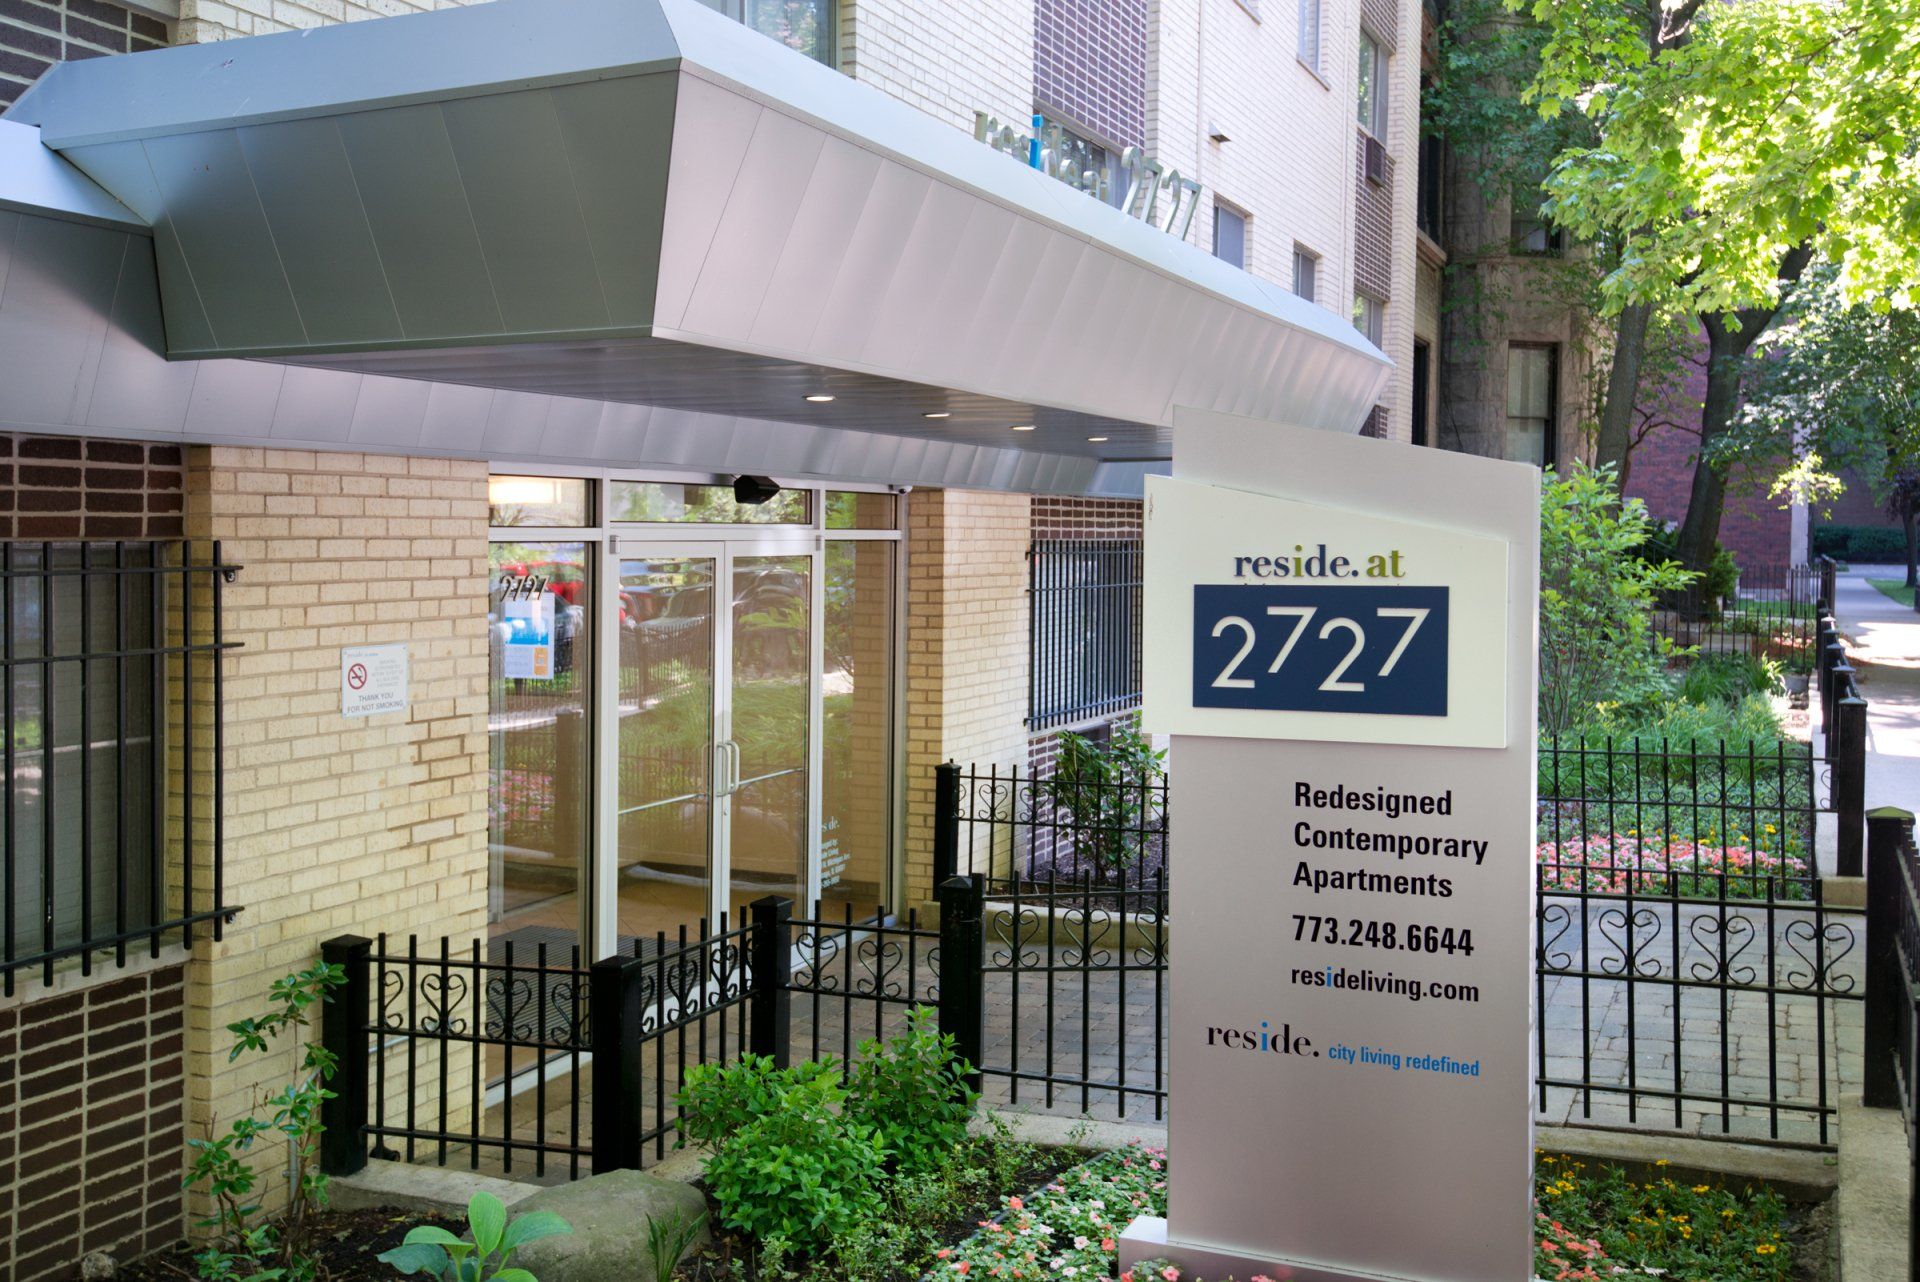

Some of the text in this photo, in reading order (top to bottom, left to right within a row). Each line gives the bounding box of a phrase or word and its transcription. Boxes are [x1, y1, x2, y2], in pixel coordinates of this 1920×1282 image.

[1211, 606, 1430, 692] 2727
[358, 692, 394, 702] THANK YOU
[376, 699, 404, 710] SMOKING
[1294, 782, 1452, 818] Redesigned
[1294, 822, 1489, 865] Contemporary
[1293, 861, 1453, 897] Apartments
[1292, 914, 1474, 957] 773.248.6644
[1291, 966, 1480, 1002] resideliving.com
[1206, 1022, 1320, 1058] reside.
[1328, 1043, 1480, 1077] city living redefined
